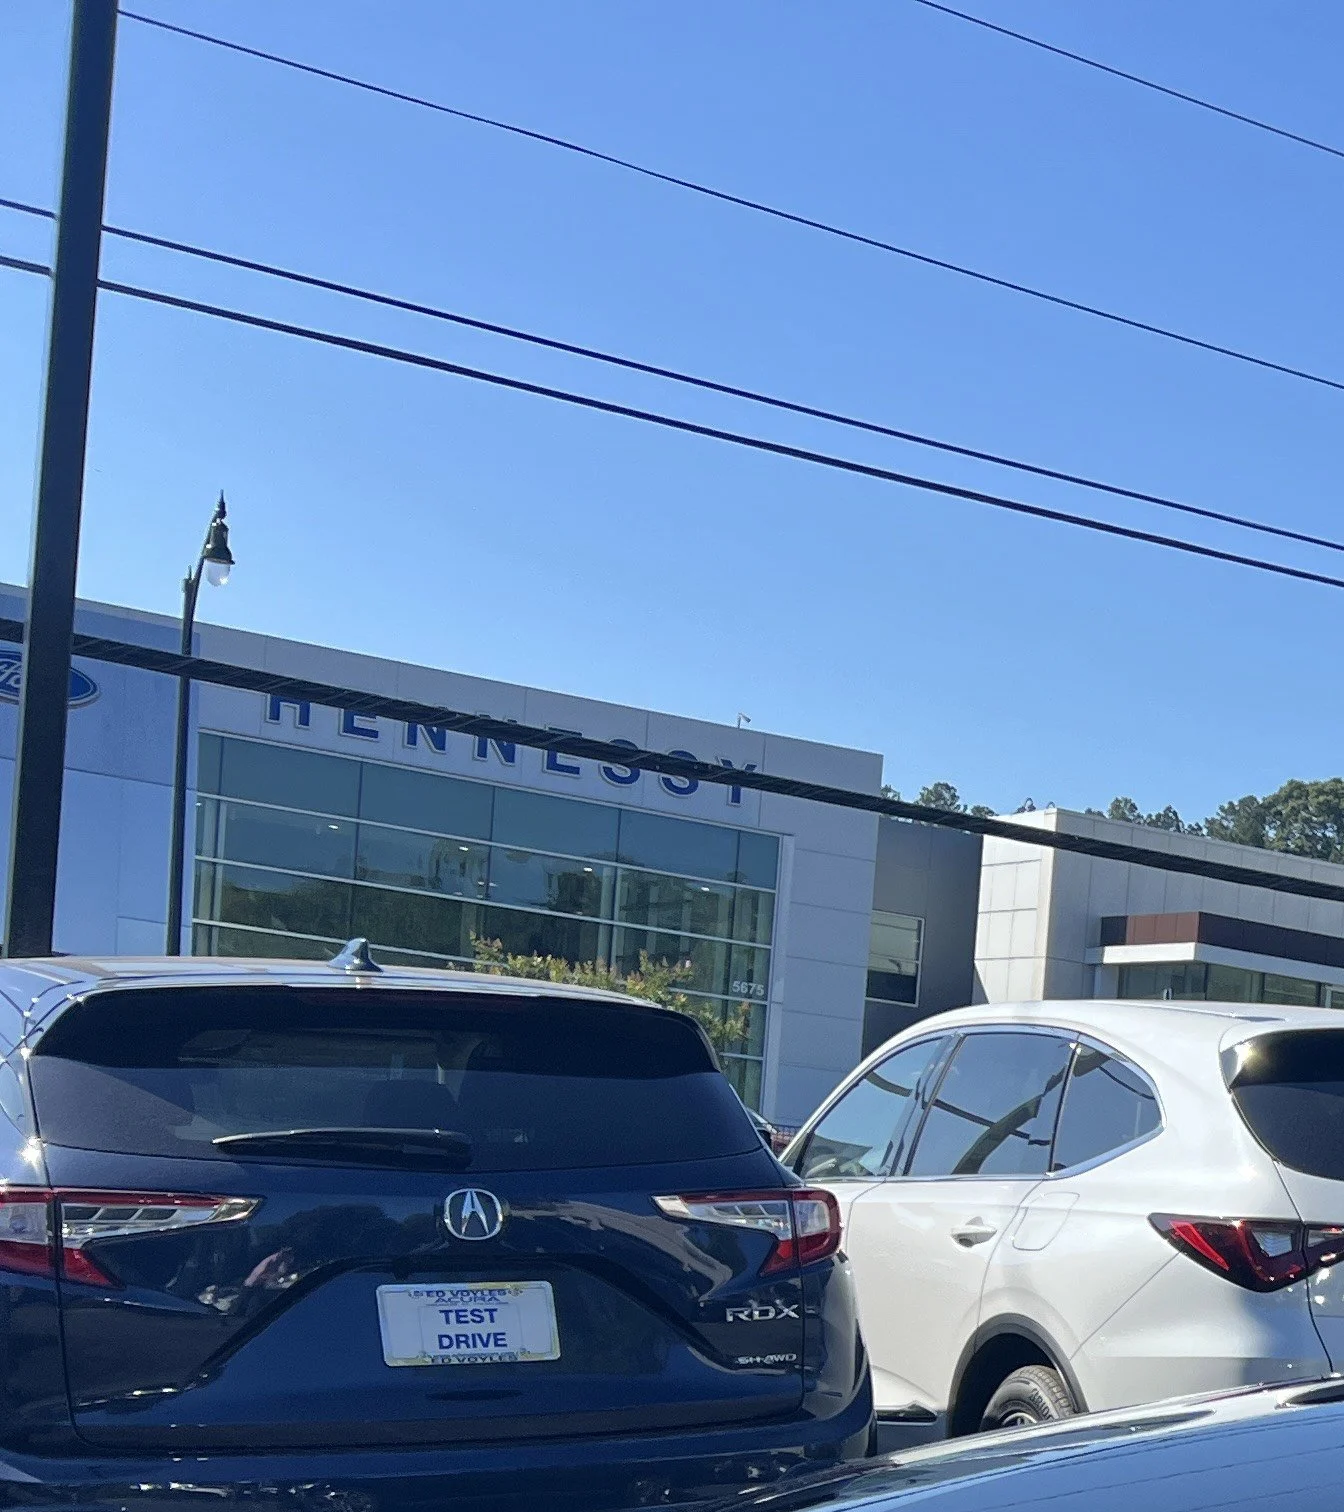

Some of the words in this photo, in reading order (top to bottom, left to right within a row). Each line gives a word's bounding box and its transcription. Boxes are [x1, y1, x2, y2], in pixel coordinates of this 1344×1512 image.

[266, 688, 758, 808] HENNESSY
[732, 980, 765, 996] 5675
[439, 1308, 498, 1325] TEST
[726, 1299, 799, 1322] RDX
[438, 1332, 508, 1350] DRIVE
